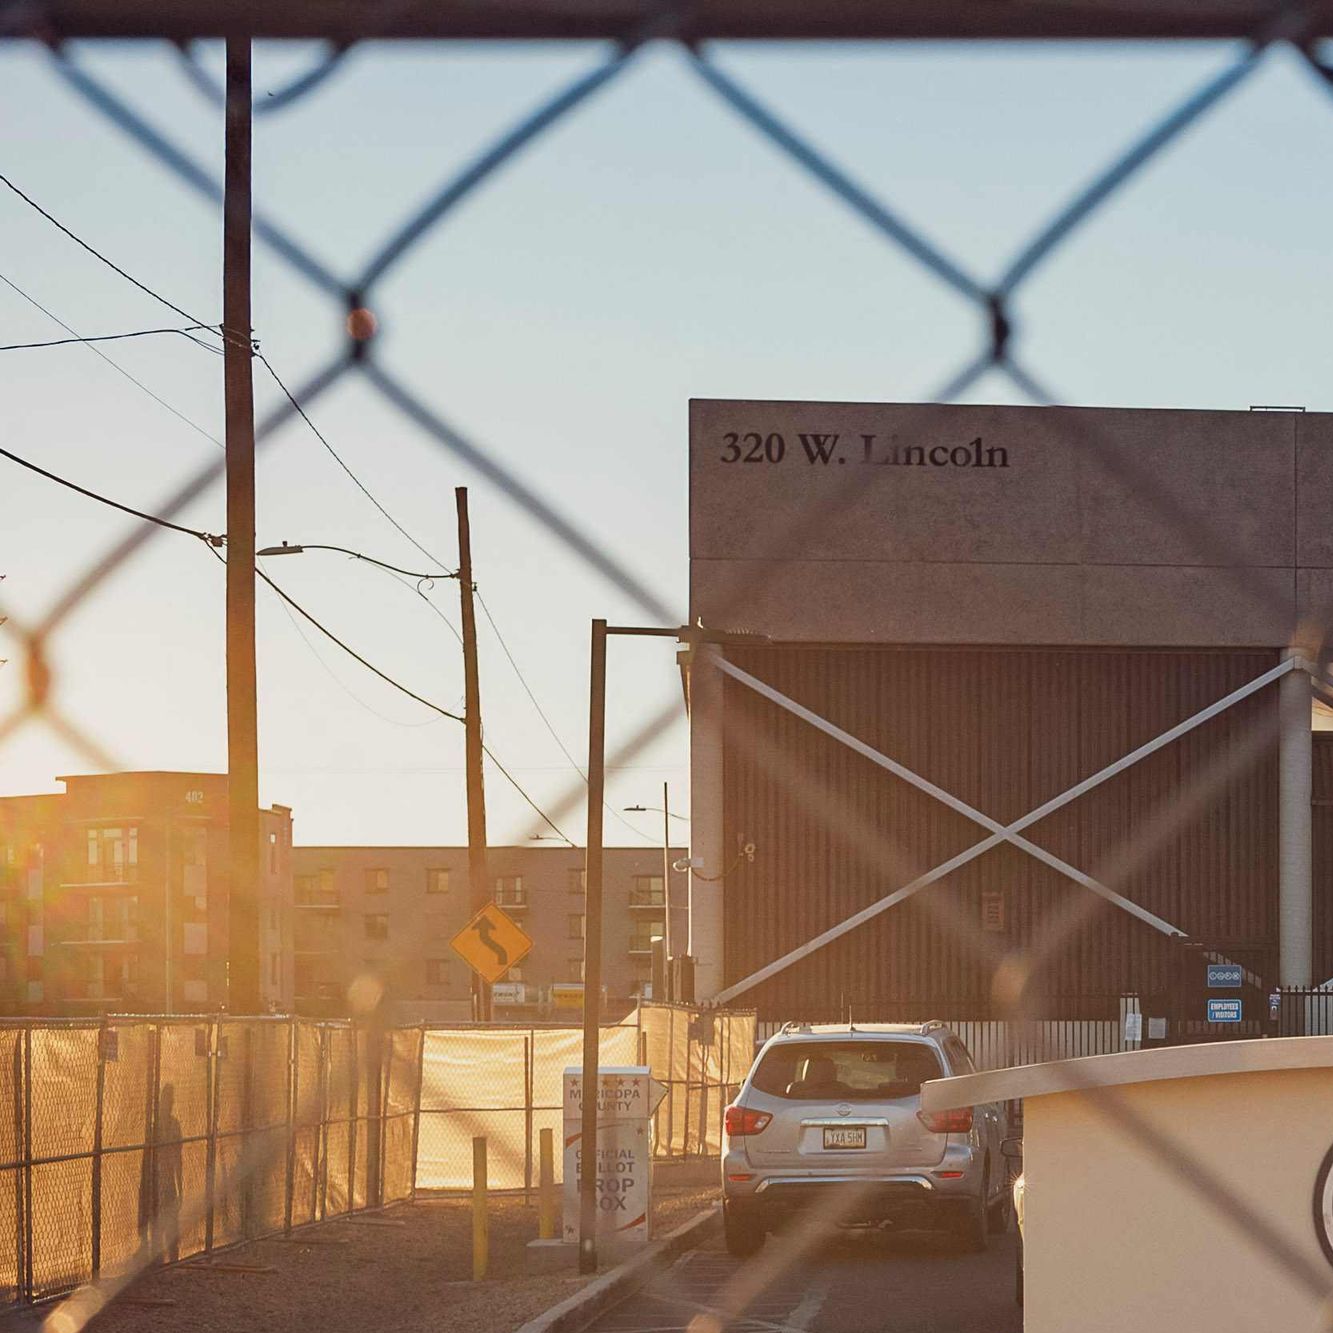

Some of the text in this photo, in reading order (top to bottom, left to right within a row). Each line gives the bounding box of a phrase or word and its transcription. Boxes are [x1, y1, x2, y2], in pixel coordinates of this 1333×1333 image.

[720, 432, 1010, 468] 320 W. Lincoln
[570, 1089, 640, 1099] MICOPA
[578, 1101, 632, 1111] CUNTY
[576, 1150, 635, 1160] OICIAL
[576, 1162, 635, 1173] BLLOT
[577, 1178, 635, 1193] ROP
[594, 1196, 627, 1211] OX
